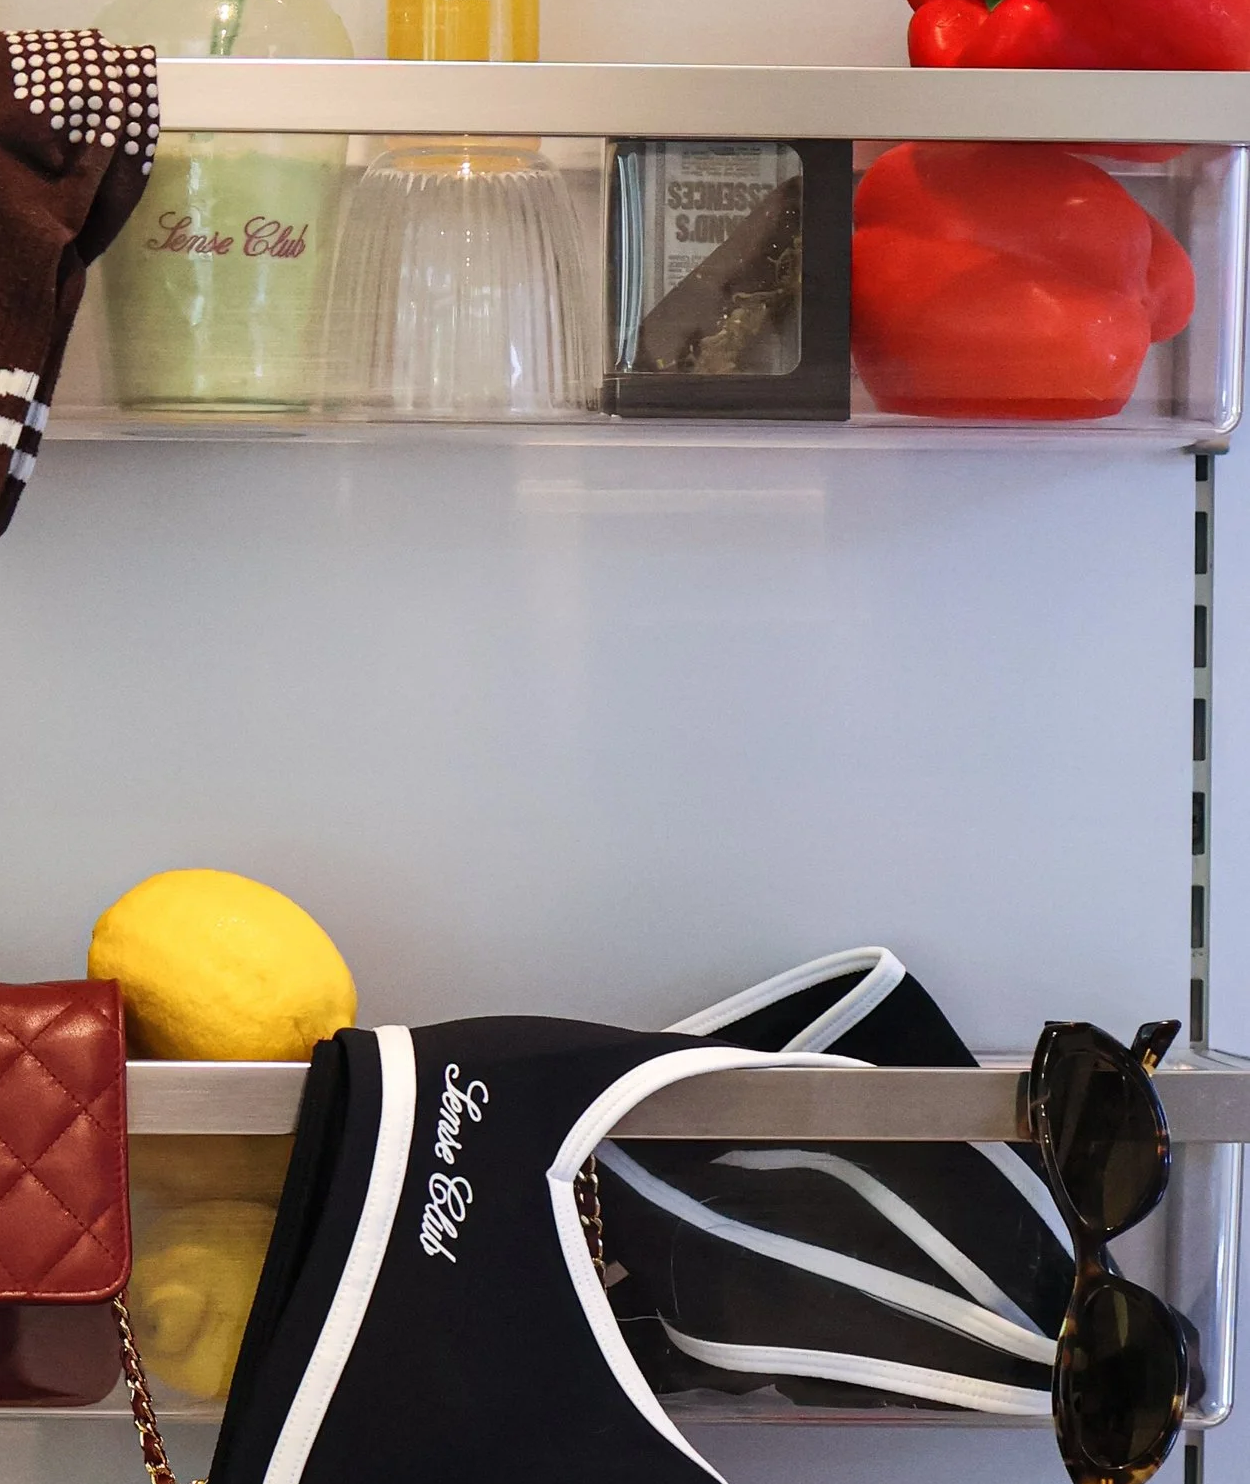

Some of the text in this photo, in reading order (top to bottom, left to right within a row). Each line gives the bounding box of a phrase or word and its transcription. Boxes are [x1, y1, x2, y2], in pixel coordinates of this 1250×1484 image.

[667, 180, 775, 212] SSENCES
[147, 211, 309, 259] Sense Club
[419, 1063, 490, 1263] Sense Club
